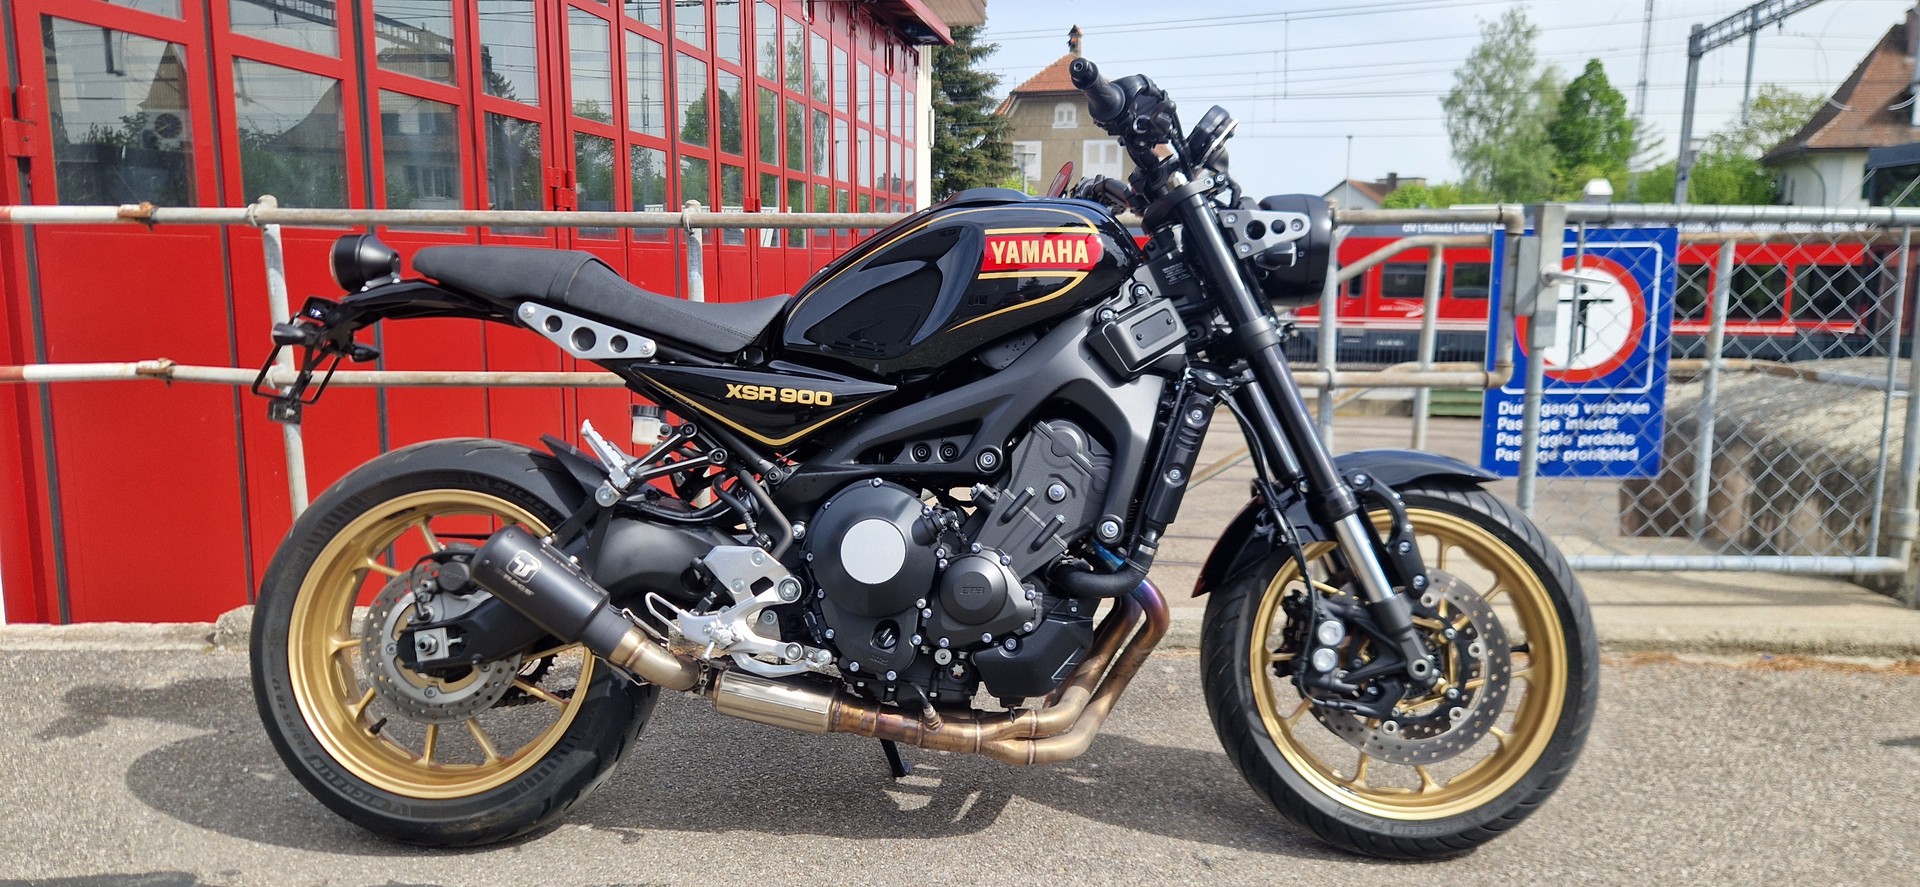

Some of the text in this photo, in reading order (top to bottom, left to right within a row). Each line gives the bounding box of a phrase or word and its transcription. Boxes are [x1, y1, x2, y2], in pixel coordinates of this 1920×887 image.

[990, 239, 1089, 264] YAMAHA
[725, 383, 833, 406] XSR 900
[1498, 401, 1650, 417] Durgang verboten
[1497, 416, 1619, 433] Pasge interdit
[1496, 431, 1636, 448] Pasggio proibito
[1495, 446, 1640, 464] Pasge prohibited
[309, 754, 386, 811] MICHELIN
